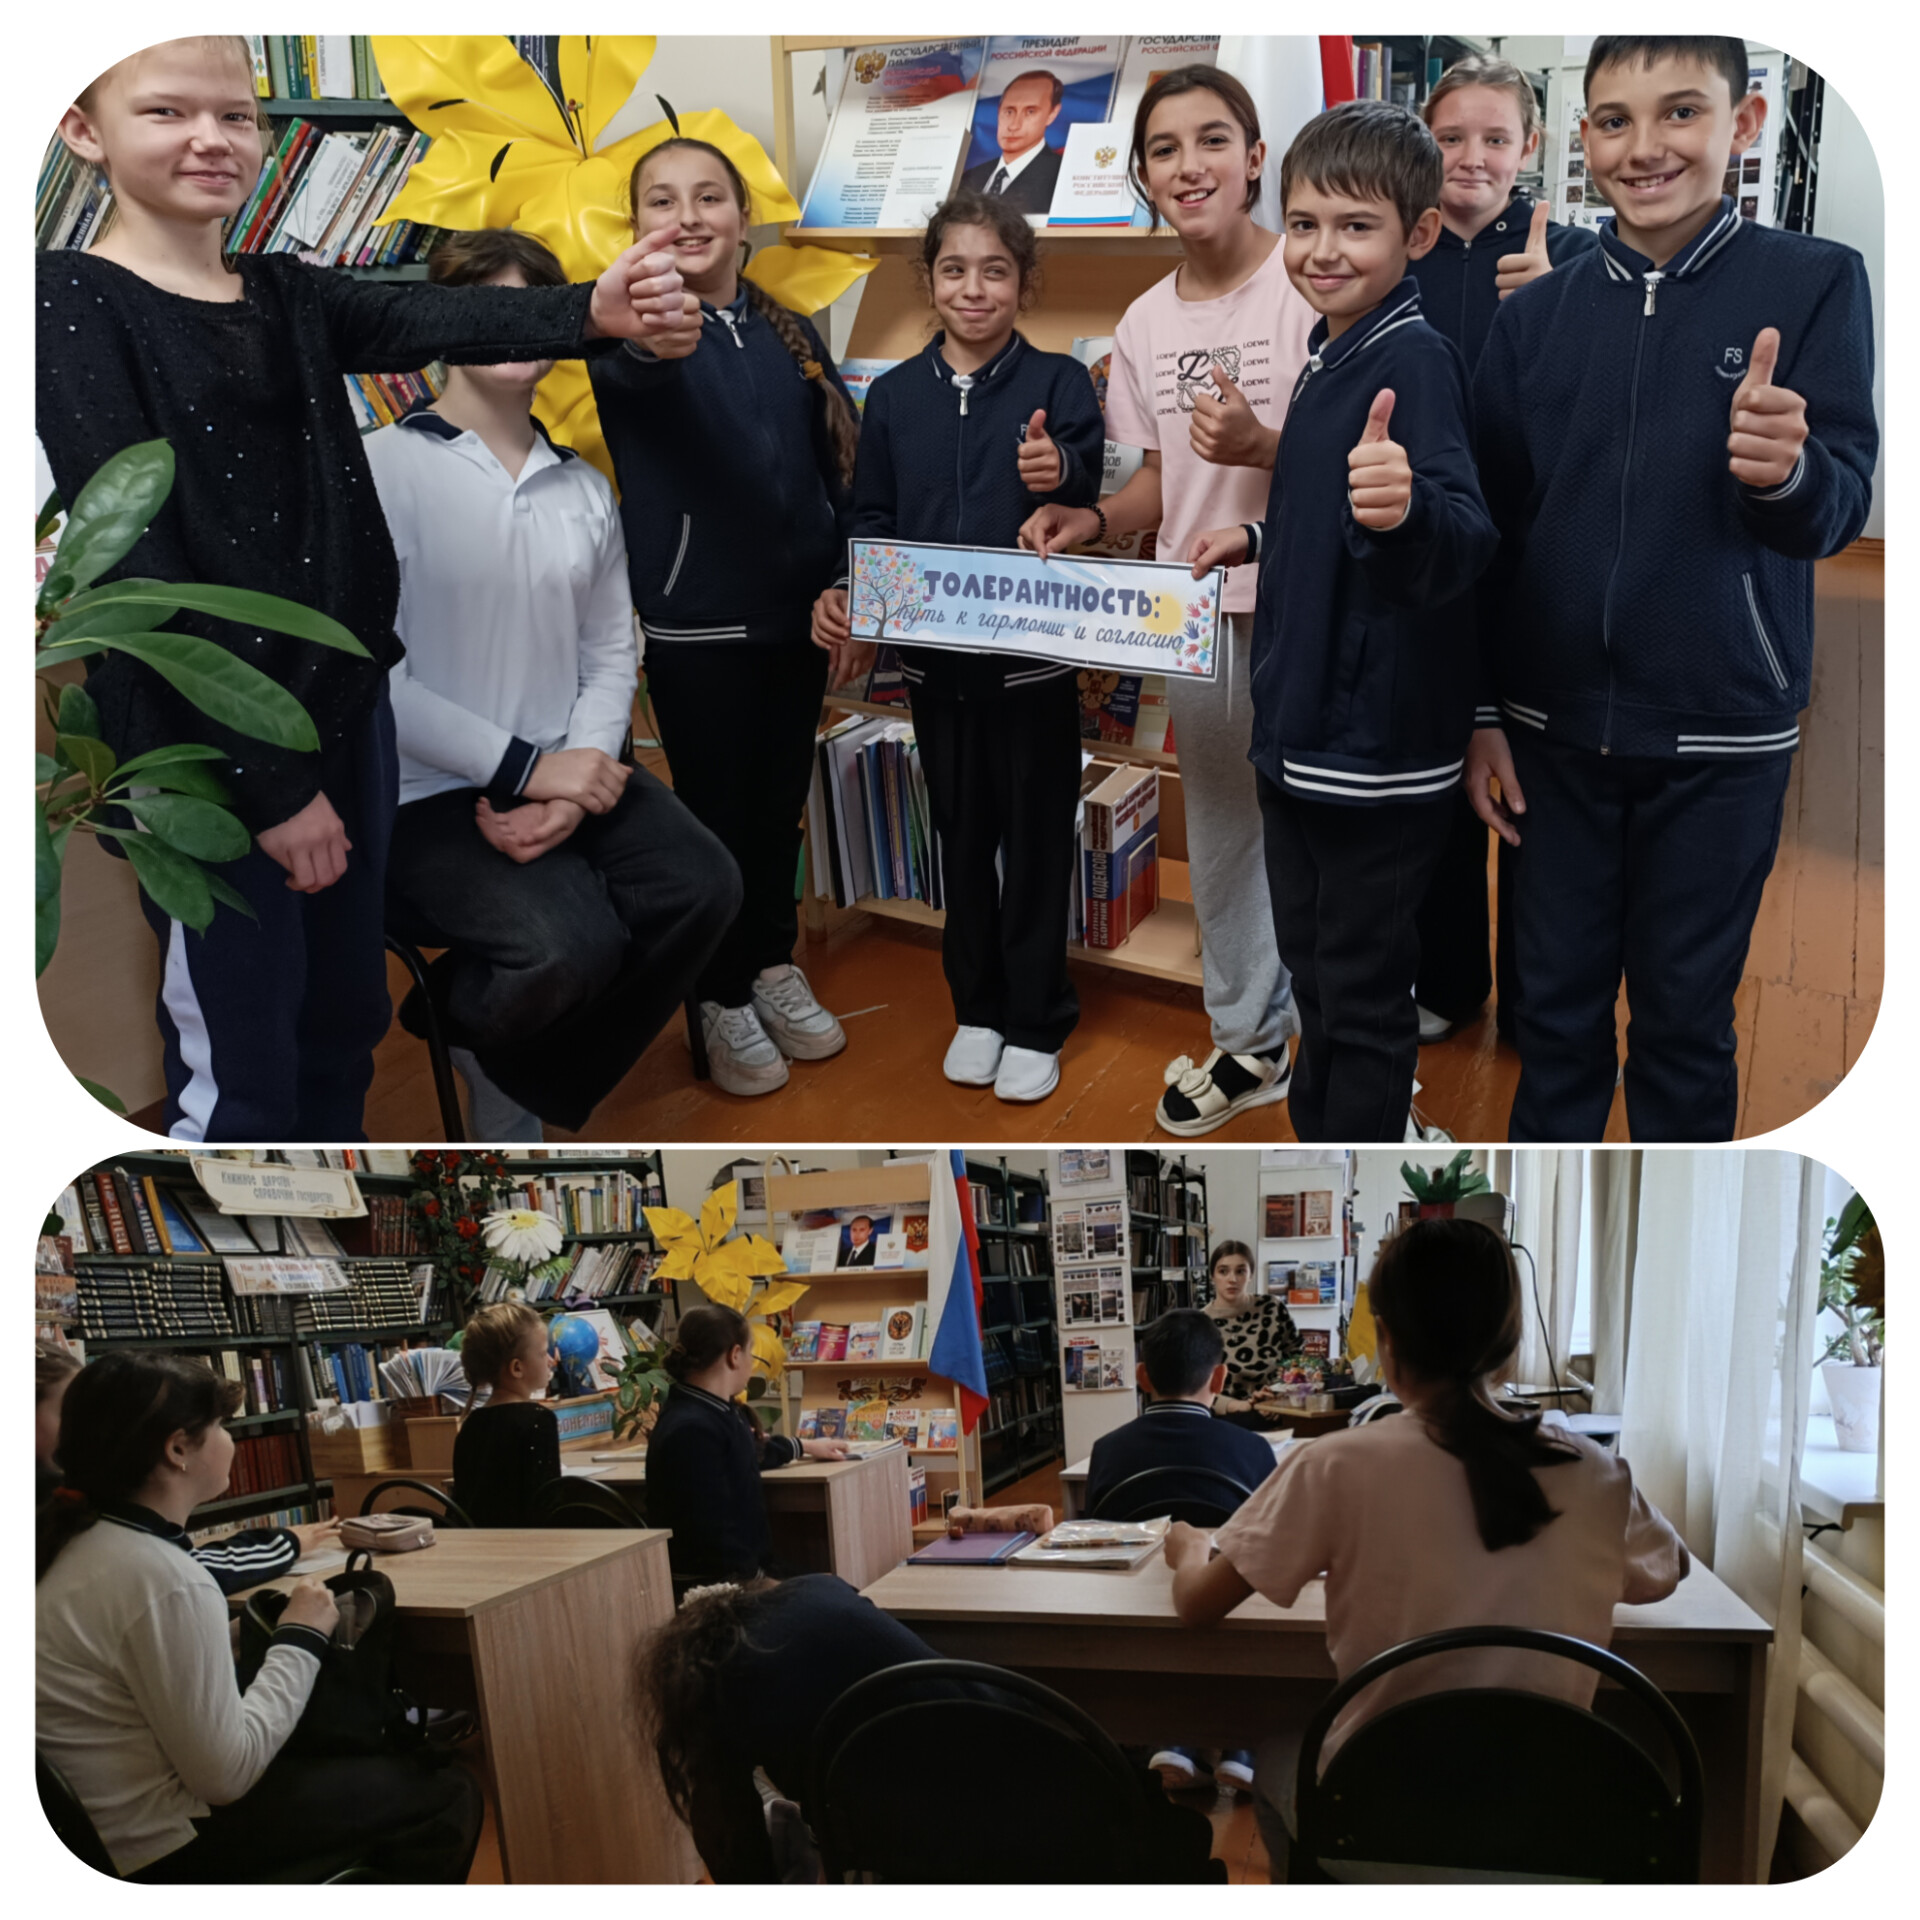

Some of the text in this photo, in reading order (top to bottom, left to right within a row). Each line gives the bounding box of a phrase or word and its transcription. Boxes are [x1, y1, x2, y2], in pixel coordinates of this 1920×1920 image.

[1022, 36, 1080, 49] ПРЕЗИДЕНТ
[991, 45, 1107, 61] РОССИЙСКОЙ ФЕДЕРАЦИИ
[1141, 44, 1211, 55] РОССИЙСКОЙ
[1156, 352, 1177, 360] LOEWE
[1243, 339, 1270, 349] LOEWE
[1724, 347, 1743, 364] FS
[1243, 358, 1270, 367] LOEWE
[1155, 369, 1176, 378] LOEWE
[1242, 378, 1270, 387] LOEWE
[1156, 388, 1175, 397] LOEWE
[1248, 398, 1271, 406] OEWE
[1157, 407, 1178, 416] LOEWE
[1020, 424, 1029, 436] F
[924, 570, 1160, 618] ТОЛЕРАНТНОСТЬ:
[898, 606, 1183, 650] путь к гармонии и согласию
[1092, 851, 1108, 899] КОДЕКСОВ
[1100, 902, 1108, 946] СБОРНИК
